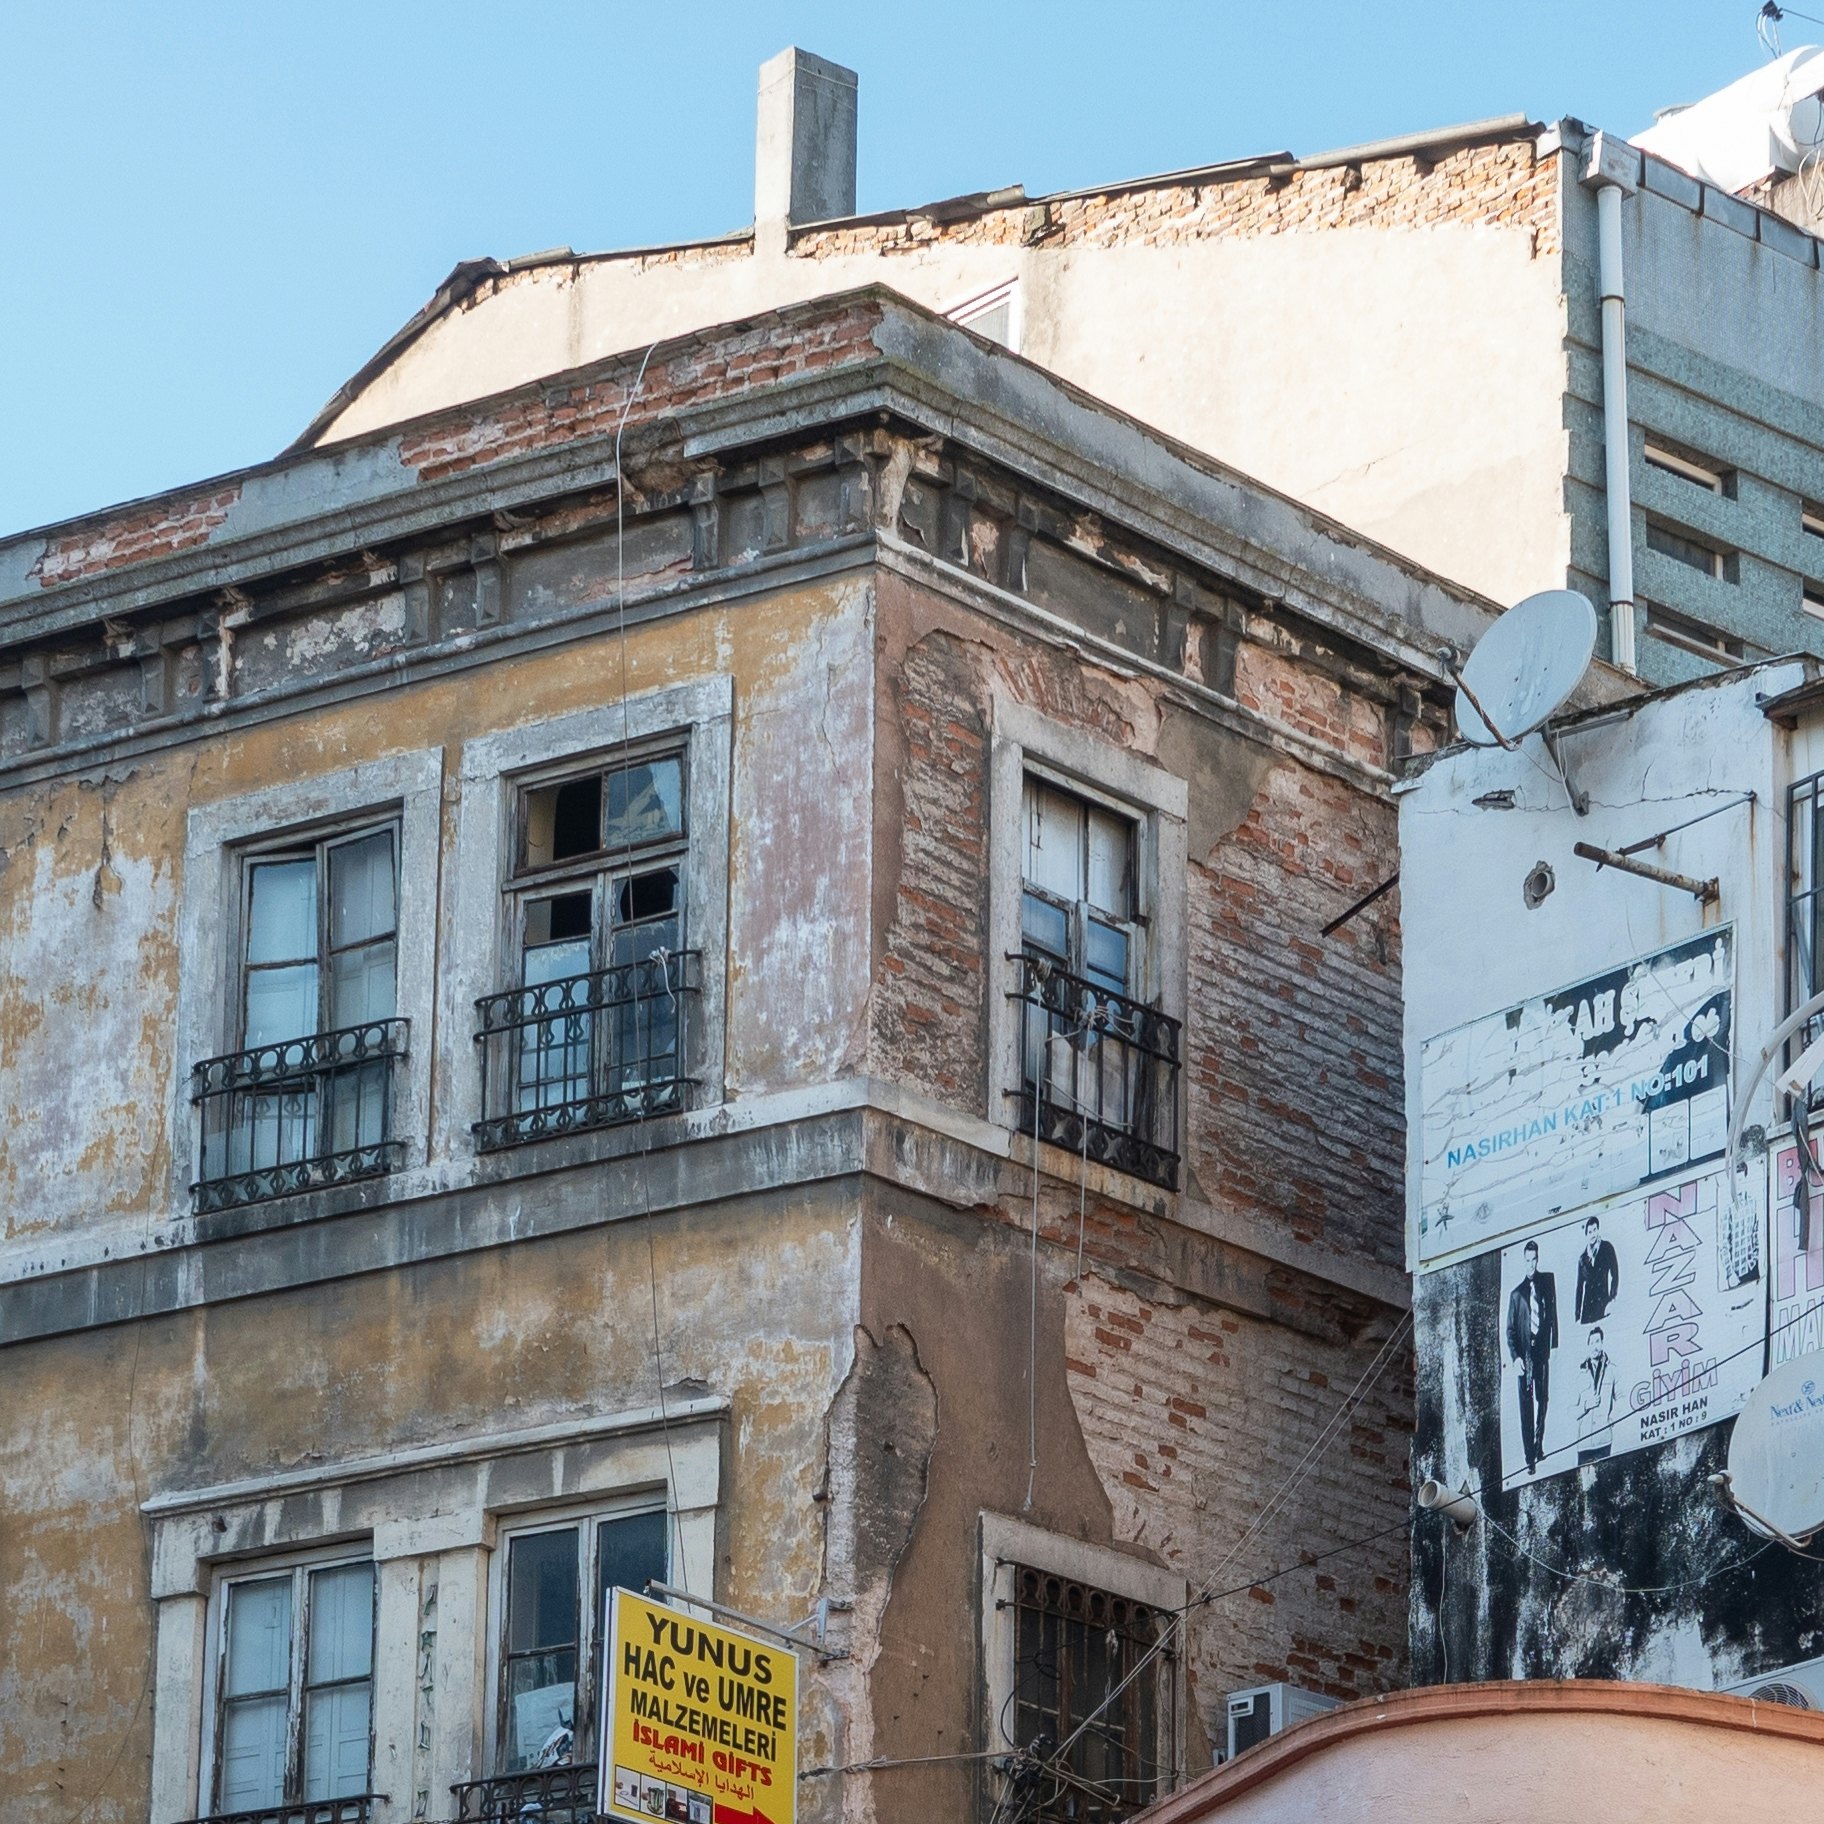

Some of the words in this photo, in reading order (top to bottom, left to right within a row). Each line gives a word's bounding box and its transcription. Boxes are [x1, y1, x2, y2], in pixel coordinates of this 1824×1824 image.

[1447, 1111, 1558, 1170] NASIRHAN
[1630, 1054, 1709, 1102] NO:101
[1642, 1179, 1704, 1368] NAZAR
[1629, 1356, 1718, 1413] GİYİM
[1640, 1406, 1680, 1430] NASIR
[1682, 1396, 1709, 1418] HAN
[1640, 1424, 1663, 1442] KAT
[1679, 1417, 1694, 1432] NO
[1700, 1410, 1708, 1423] 9
[646, 1612, 772, 1684] YUNUS
[624, 1642, 675, 1691] HAC
[684, 1671, 710, 1703] ve
[718, 1676, 787, 1731] UMRE
[630, 1688, 777, 1762] MALZEMELERİ
[632, 1719, 705, 1764] İSLAMİ
[712, 1751, 773, 1786] GİFTS
[648, 1751, 710, 1788] الإسلامية
[714, 1775, 755, 1800] الهدايا
